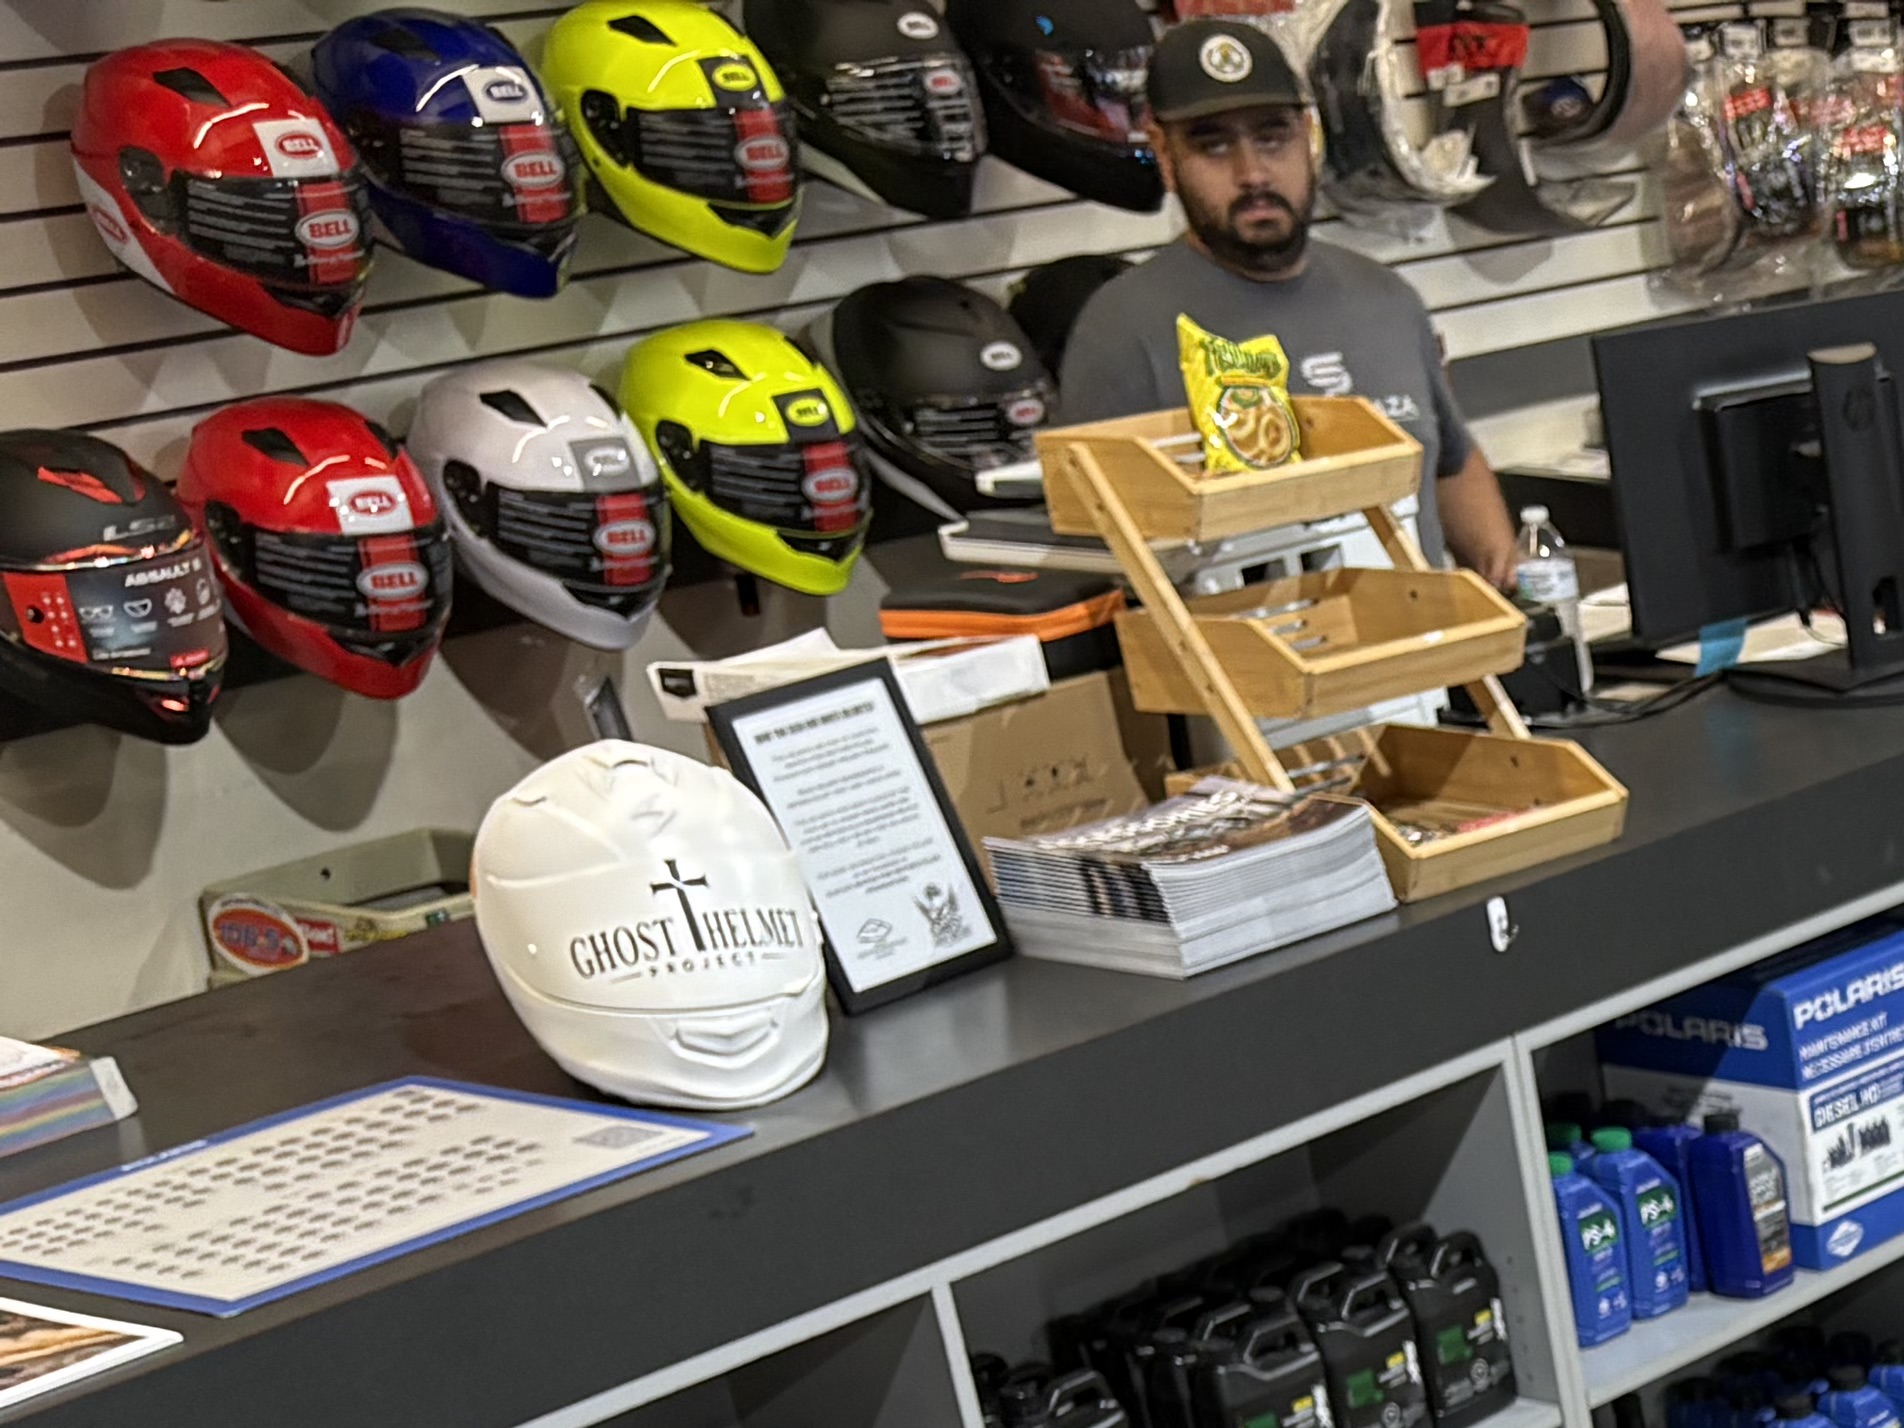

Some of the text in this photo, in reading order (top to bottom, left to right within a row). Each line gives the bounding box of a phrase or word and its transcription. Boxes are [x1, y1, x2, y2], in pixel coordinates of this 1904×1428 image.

[514, 162, 558, 178] BELL
[308, 222, 352, 239] BELL
[606, 528, 648, 545] BELL
[370, 572, 418, 590] BELL
[569, 906, 806, 980] GHOST HELMET
[1614, 1010, 1769, 1051] POLARIS
